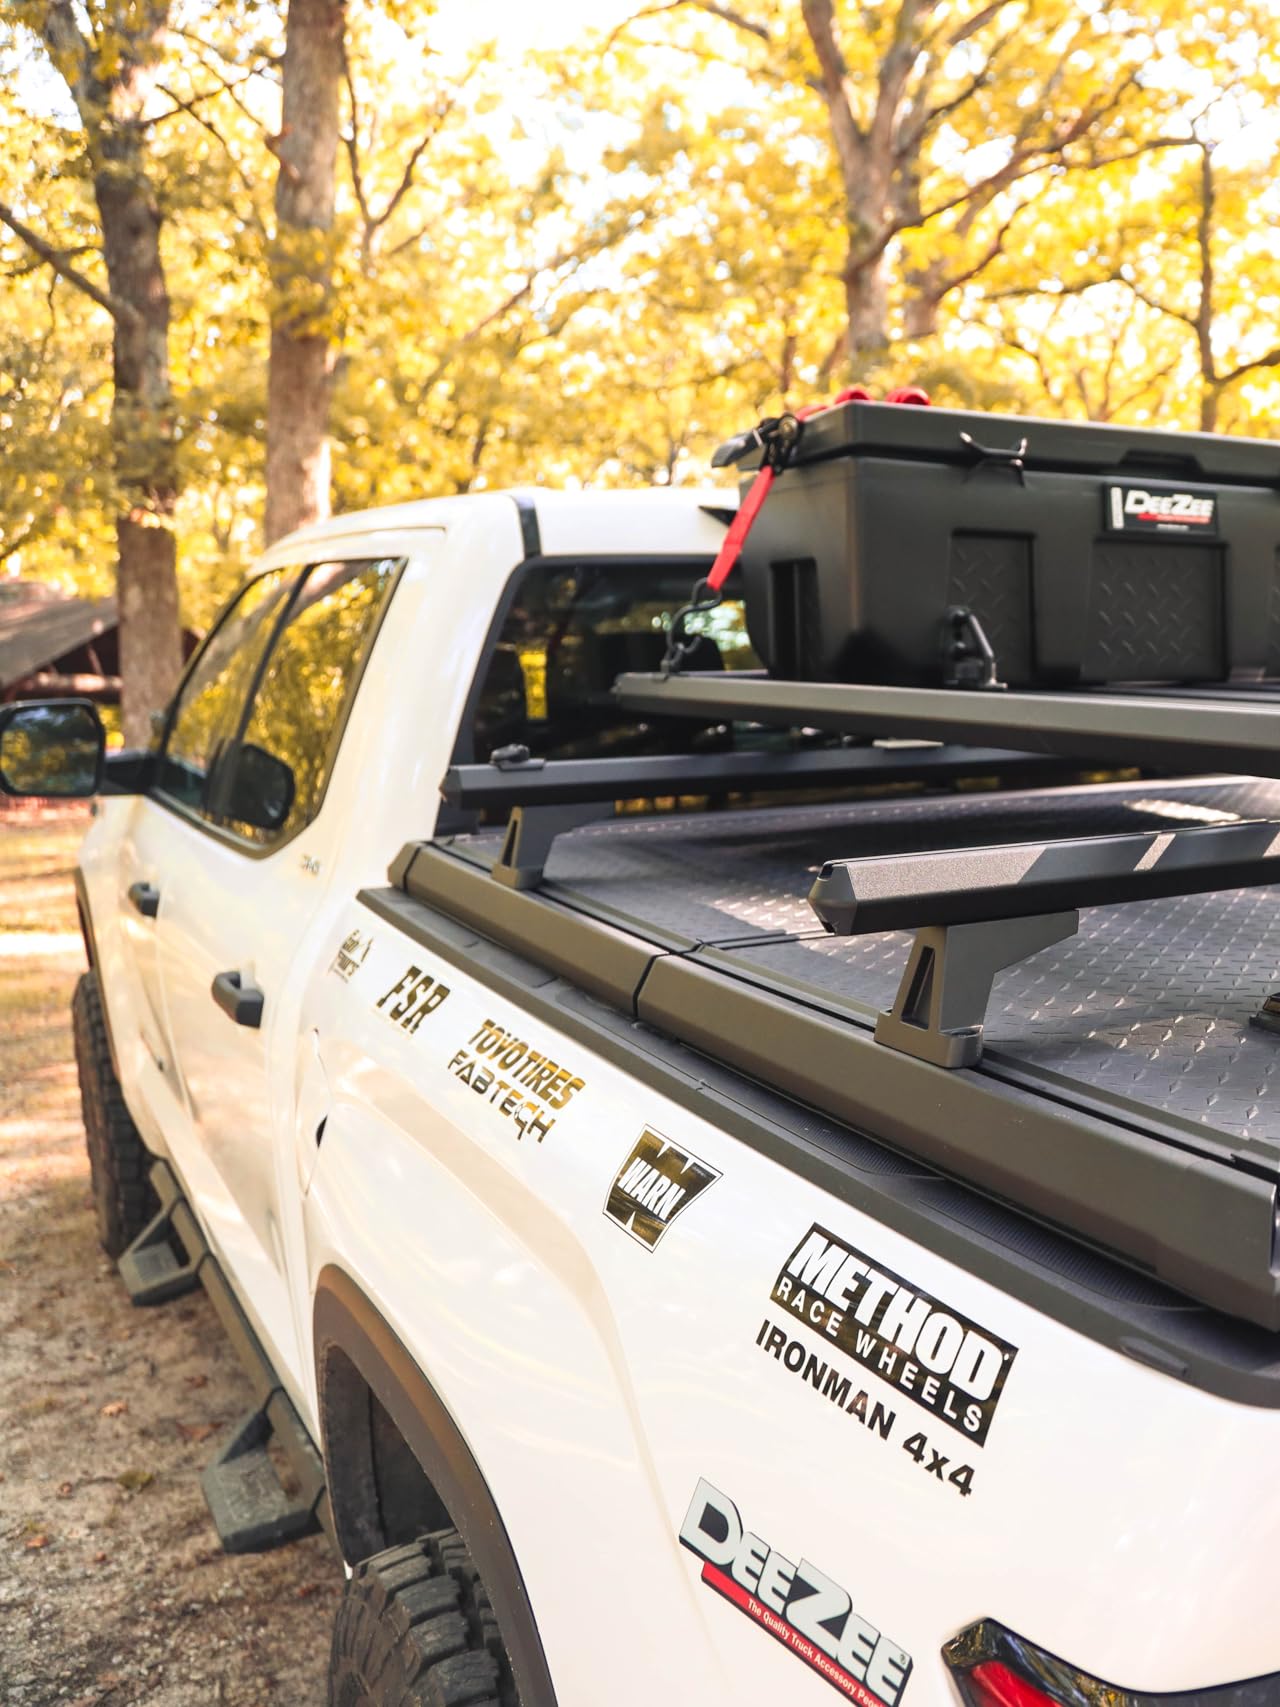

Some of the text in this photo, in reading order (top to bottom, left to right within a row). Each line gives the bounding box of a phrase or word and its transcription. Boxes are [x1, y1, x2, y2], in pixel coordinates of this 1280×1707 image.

[376, 965, 451, 1035] FSR
[447, 1050, 556, 1143] FABTECH
[617, 1156, 686, 1221] WARN
[776, 1276, 983, 1433] RACE WHEELS
[785, 1231, 1003, 1401] METHOD
[755, 1319, 975, 1497] IRONMAN 4x4
[748, 1598, 762, 1617] The
[763, 1611, 790, 1639] Quality
[791, 1634, 813, 1659] Truck
[814, 1654, 857, 1695] Accessory
